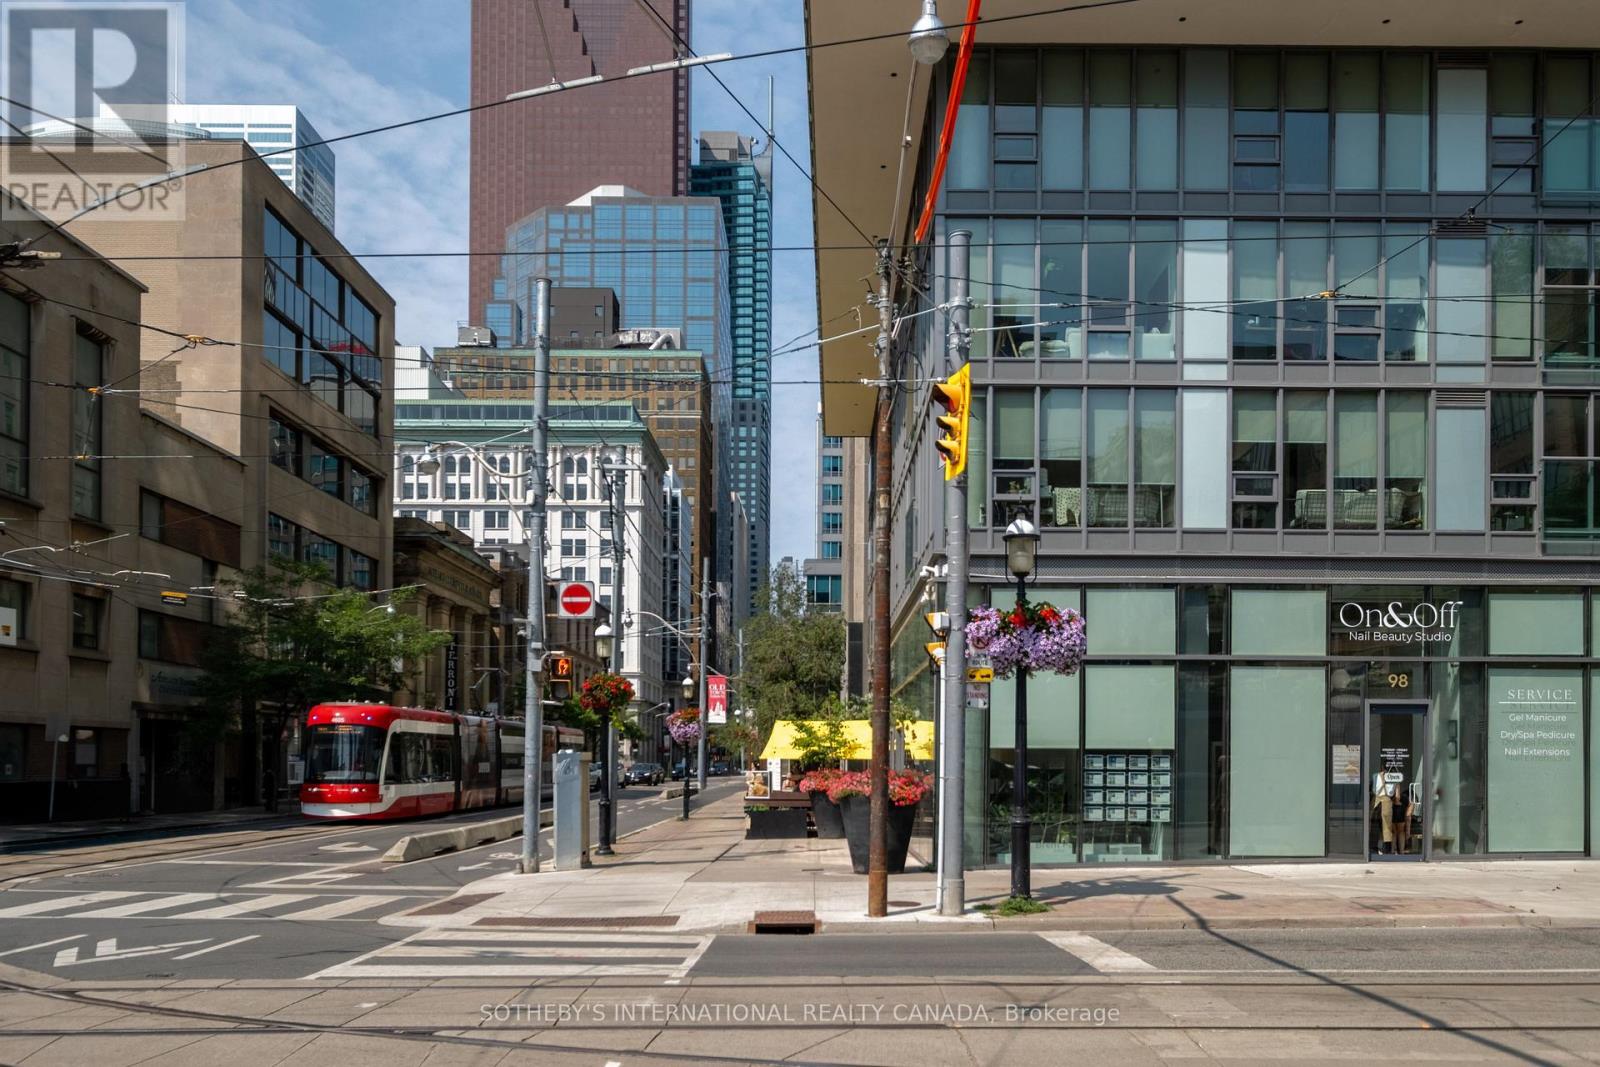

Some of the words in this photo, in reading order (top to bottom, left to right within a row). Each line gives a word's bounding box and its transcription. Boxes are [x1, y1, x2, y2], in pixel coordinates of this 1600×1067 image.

[1339, 601, 1464, 628] On&Off
[1349, 632, 1370, 641] Nail
[1373, 632, 1413, 644] Beauty
[1414, 632, 1452, 641] Studio
[447, 642, 457, 706] TERRONI
[708, 683, 726, 691] OLD
[1388, 674, 1409, 688] 98
[1507, 688, 1573, 700] SERVICE
[1525, 713, 1567, 721] Manicure
[1500, 730, 1535, 740] Dry/Spa
[1536, 730, 1576, 739] Pedicure
[1504, 747, 1522, 756] Nail
[1523, 747, 1571, 756] Extensions
